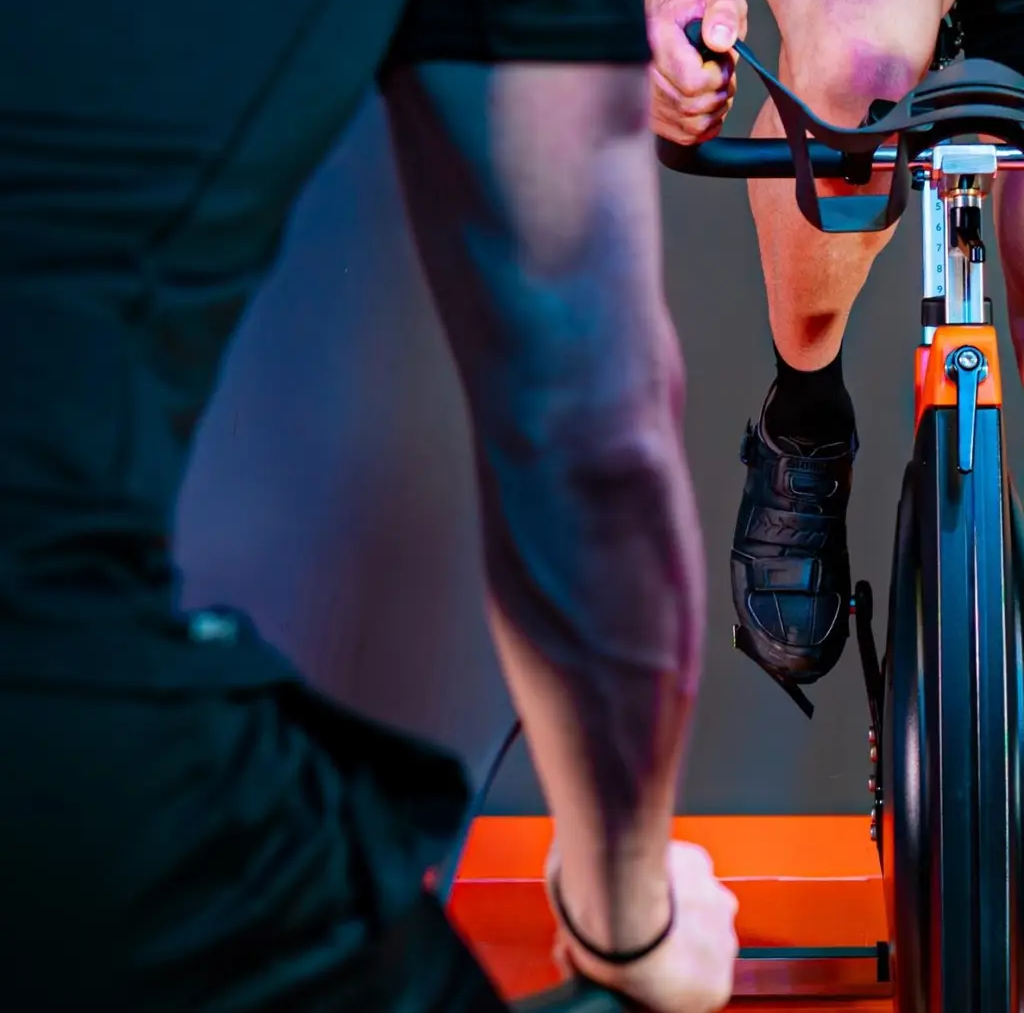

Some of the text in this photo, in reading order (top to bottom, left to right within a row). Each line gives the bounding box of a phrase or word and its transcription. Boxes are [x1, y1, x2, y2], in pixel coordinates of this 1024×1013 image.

[935, 202, 941, 211] 5
[935, 223, 942, 232] 6
[936, 243, 942, 252] 7
[936, 264, 943, 273] 8
[937, 285, 943, 294] 9
